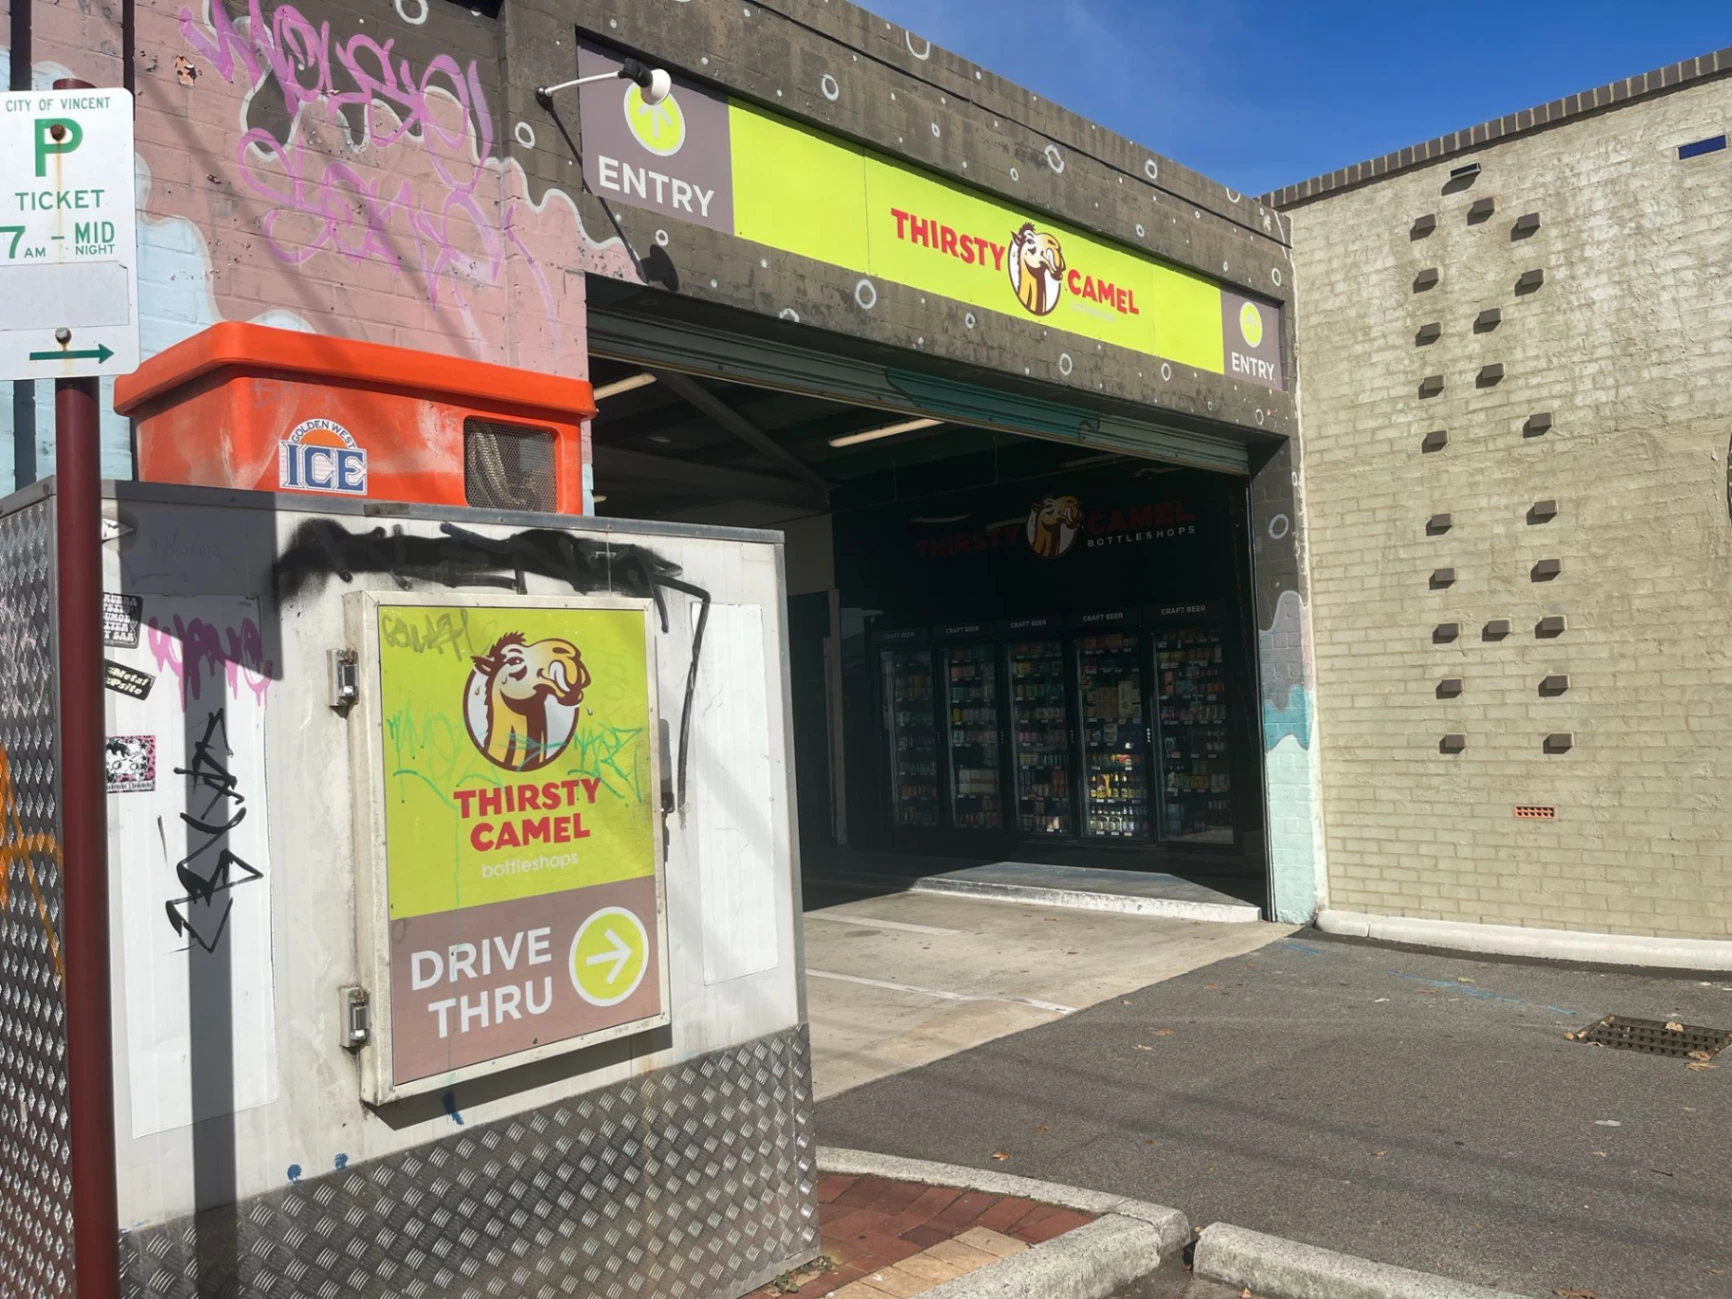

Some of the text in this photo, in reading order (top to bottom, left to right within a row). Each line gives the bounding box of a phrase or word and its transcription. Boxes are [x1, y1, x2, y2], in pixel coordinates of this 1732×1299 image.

[5, 96, 111, 112] CITY OF VINCENT
[34, 117, 83, 177] P
[14, 189, 105, 211] TICKET
[598, 154, 715, 218] ENTRY
[75, 221, 115, 244] MID
[75, 244, 115, 256] NIGHT
[890, 207, 1140, 316] THIRSTY CAMEL
[1231, 351, 1275, 381] ENTRY
[290, 420, 356, 449] GOLDEN WEST
[282, 442, 366, 493] ICE
[915, 499, 1195, 560] THIRSTY CAMEL
[1087, 525, 1197, 548] BOTTLESHOPS
[1082, 612, 1124, 622] CRAFT BEER
[1161, 604, 1207, 615] CRAFT BEER
[884, 631, 915, 640] CRAFT BEER
[945, 625, 980, 634] CRAFT BEER
[1010, 619, 1047, 629] CRAFT BEER
[453, 778, 601, 819] THIRSTY
[470, 812, 591, 852] CAMEL
[481, 851, 579, 879] bottleshops
[410, 926, 552, 991] DRIVE
[428, 976, 553, 1039] THRU
